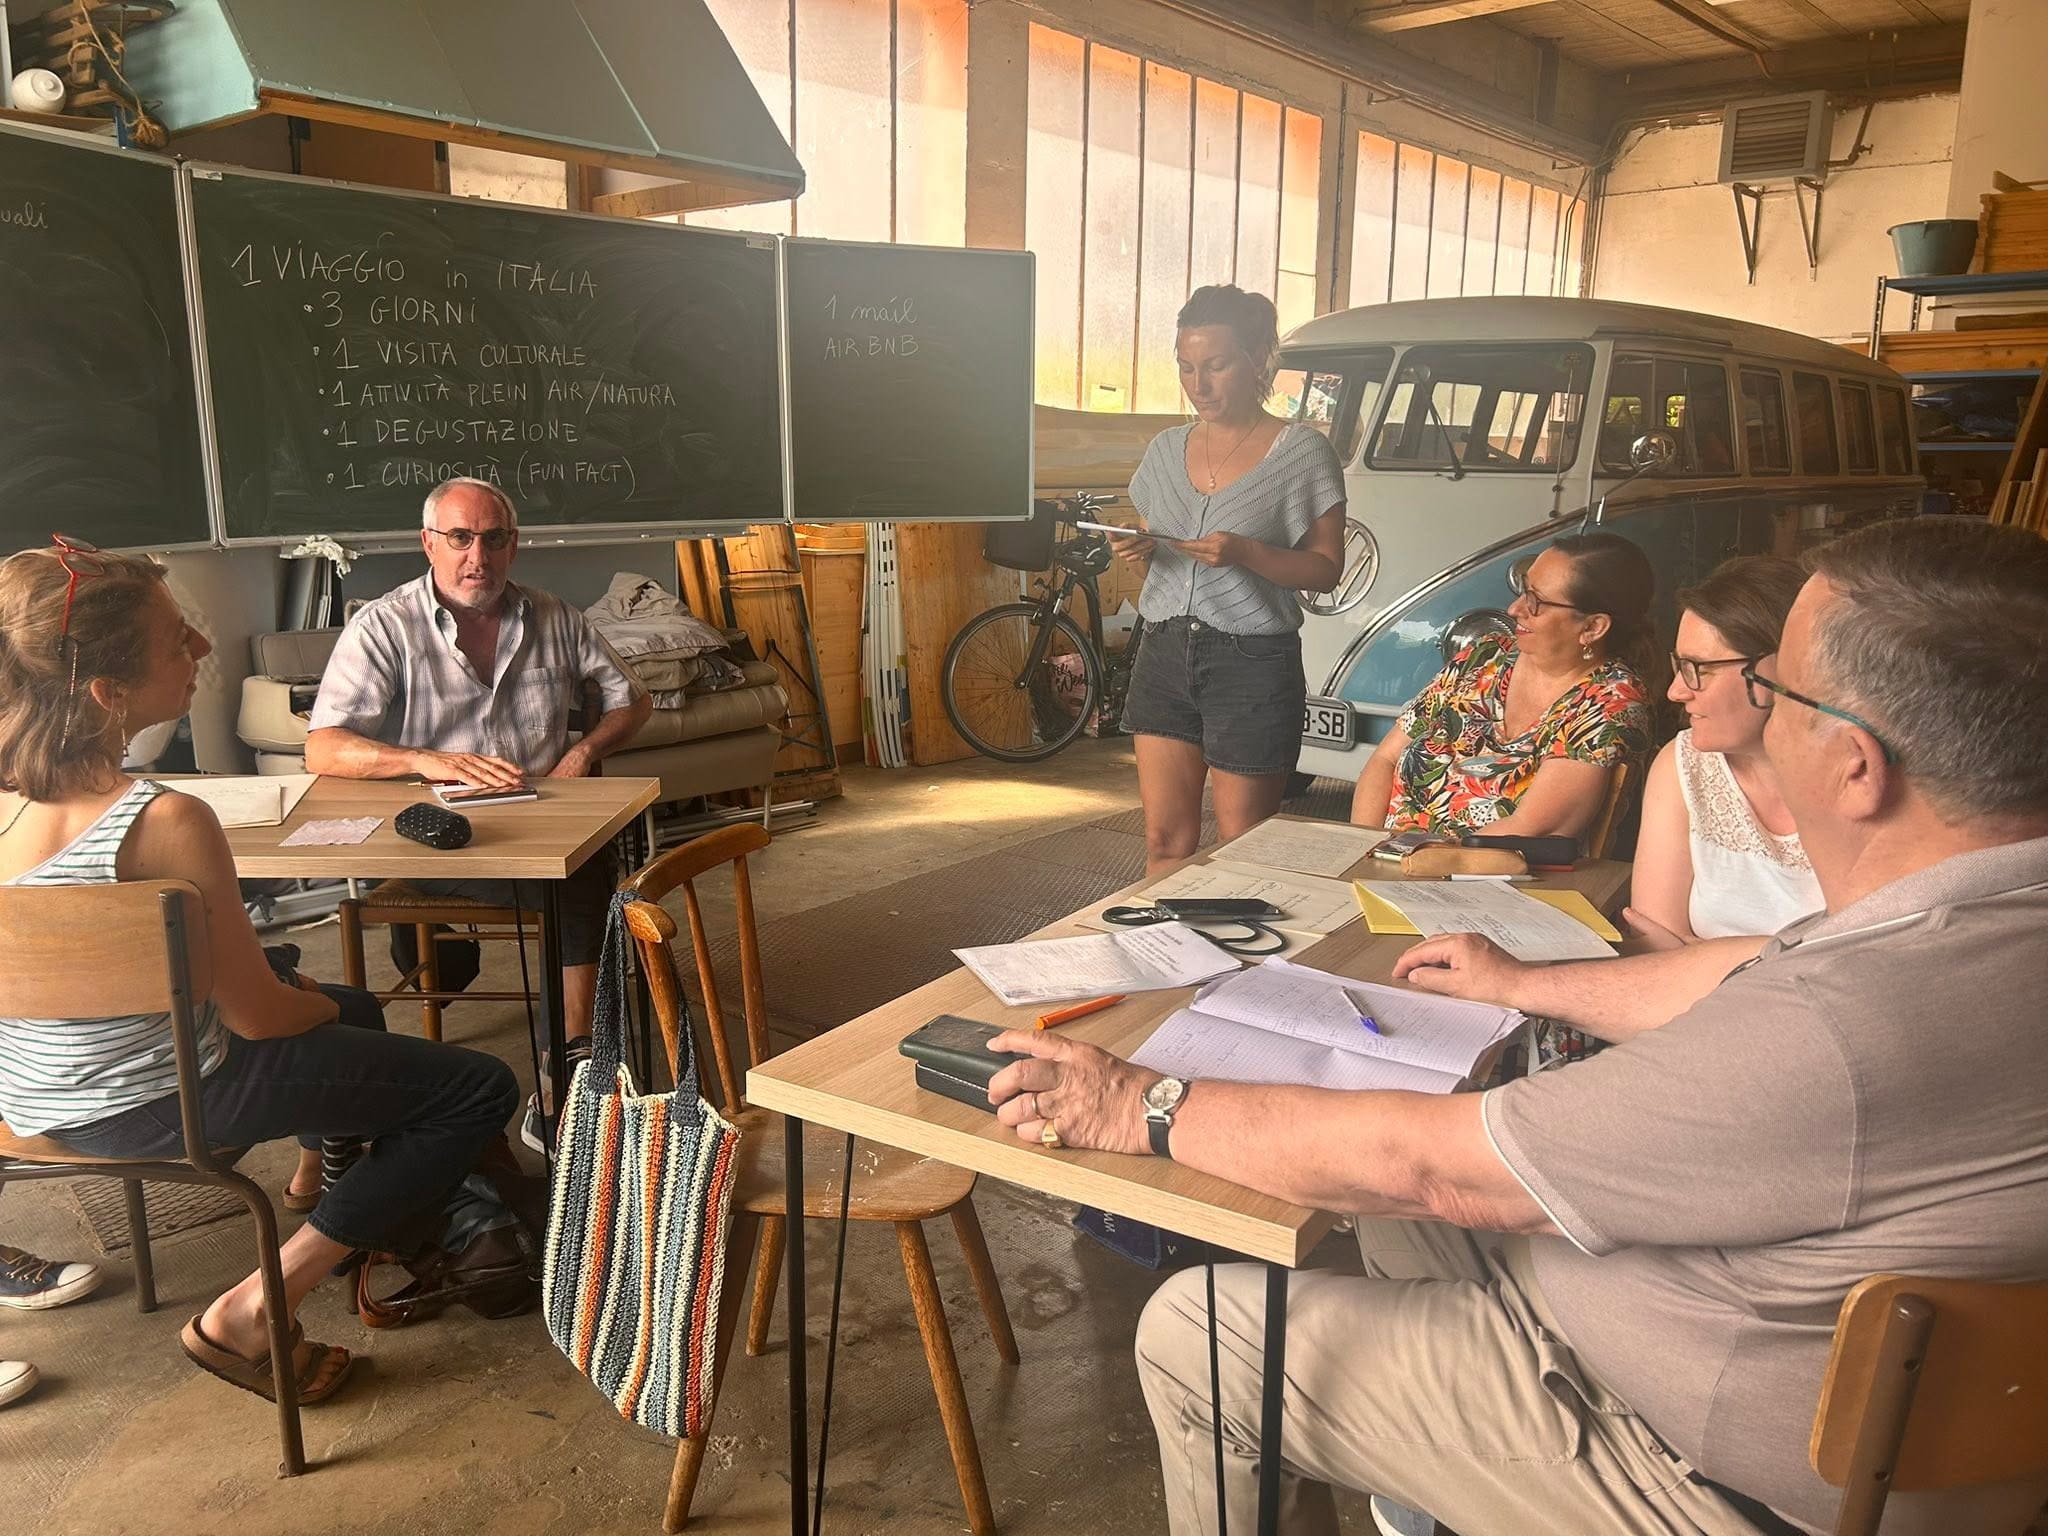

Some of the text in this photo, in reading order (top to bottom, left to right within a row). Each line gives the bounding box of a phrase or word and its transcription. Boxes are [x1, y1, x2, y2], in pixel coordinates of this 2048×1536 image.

[231, 244, 262, 287] 1
[446, 260, 468, 289] in
[498, 260, 597, 298] ITALIA
[321, 291, 344, 328] 3
[824, 294, 837, 320] 1
[333, 338, 586, 369] 1 VISITA CULTURALE
[332, 380, 351, 407] 1
[468, 382, 527, 407] PLEIN
[337, 419, 578, 448] 1 DEGUSTAZIONE
[344, 462, 365, 490] 1
[382, 455, 501, 487] CURIOSITÀ
